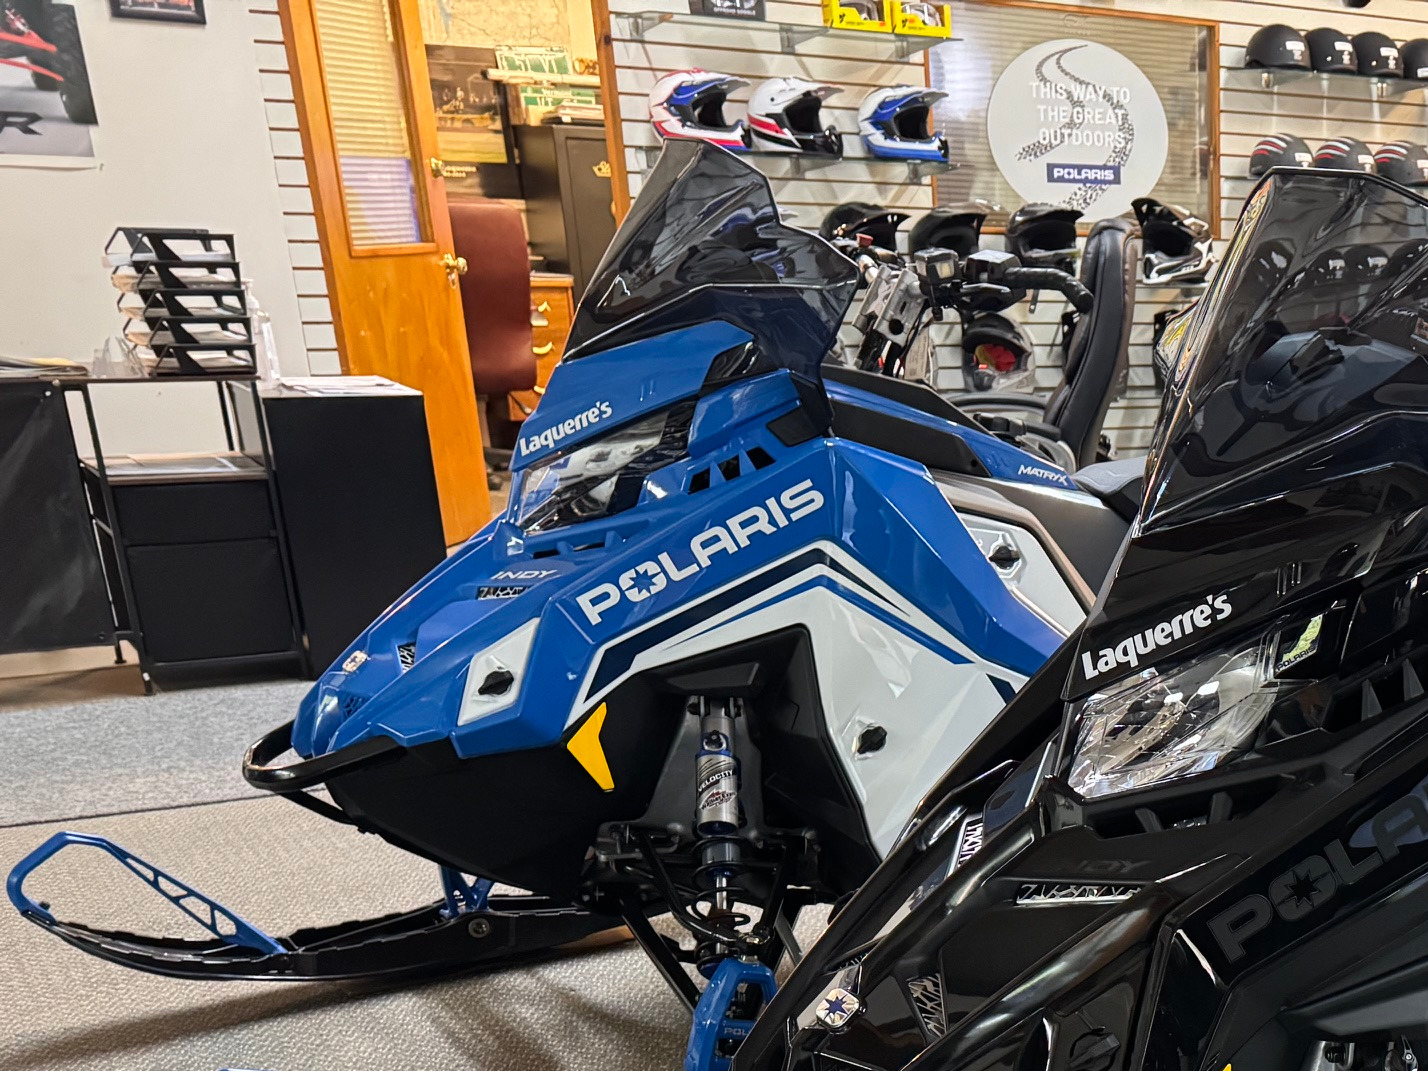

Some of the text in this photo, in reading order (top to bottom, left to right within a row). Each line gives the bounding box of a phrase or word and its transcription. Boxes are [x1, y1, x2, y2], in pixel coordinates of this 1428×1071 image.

[1029, 82, 1131, 103] THIS WAY TO
[1037, 105, 1126, 125] THE GREAT
[1039, 128, 1126, 147] OUTDOORS
[1053, 167, 1115, 180] POLARIS
[519, 401, 613, 457] Laquerre's
[1018, 464, 1068, 486] MATRYX
[575, 478, 825, 626] POLARIS
[490, 569, 558, 580] INDY
[1081, 594, 1233, 681] Laquerre's
[1275, 645, 1317, 673] POLARIS
[698, 769, 733, 792] VELOCITY
